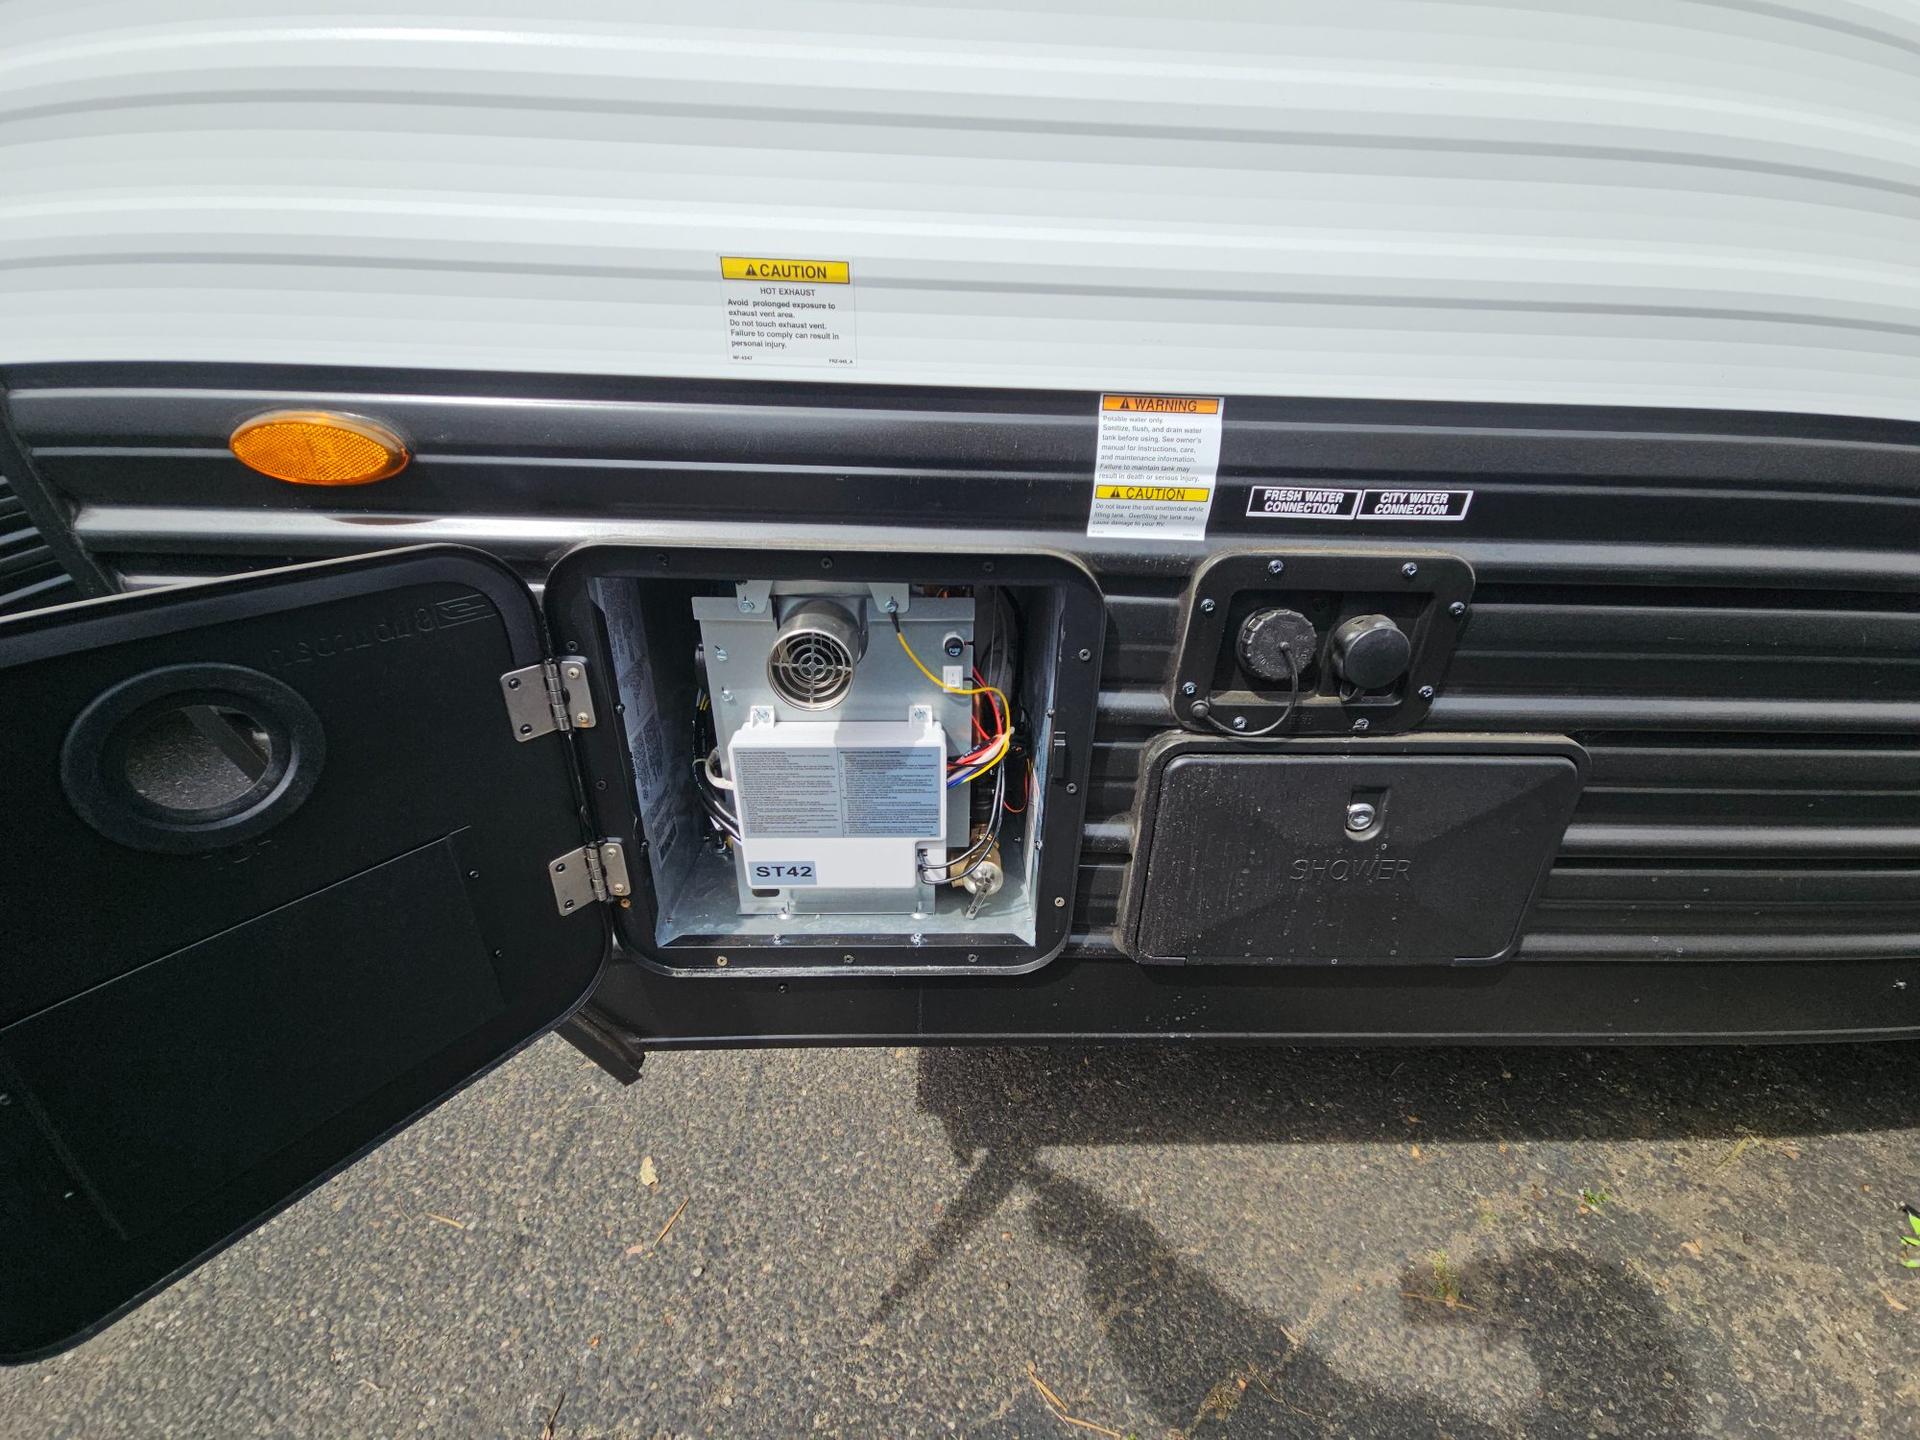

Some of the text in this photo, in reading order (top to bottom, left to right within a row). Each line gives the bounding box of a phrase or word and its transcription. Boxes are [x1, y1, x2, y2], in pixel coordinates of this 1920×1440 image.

[760, 264, 827, 279] CAUTION
[779, 288, 816, 296] EXHAUST
[753, 300, 790, 308] prolonged
[767, 331, 792, 339] comply
[1135, 398, 1197, 411] WARNING
[1126, 487, 1186, 500] CAUTION
[1264, 490, 1344, 502] FRESH WATER
[1380, 493, 1450, 504] CITY WATER
[1264, 502, 1338, 514] CONNECTION
[1374, 504, 1448, 515] CONNECTION
[756, 866, 812, 877] ST42
[1289, 860, 1411, 880] SHOWER
